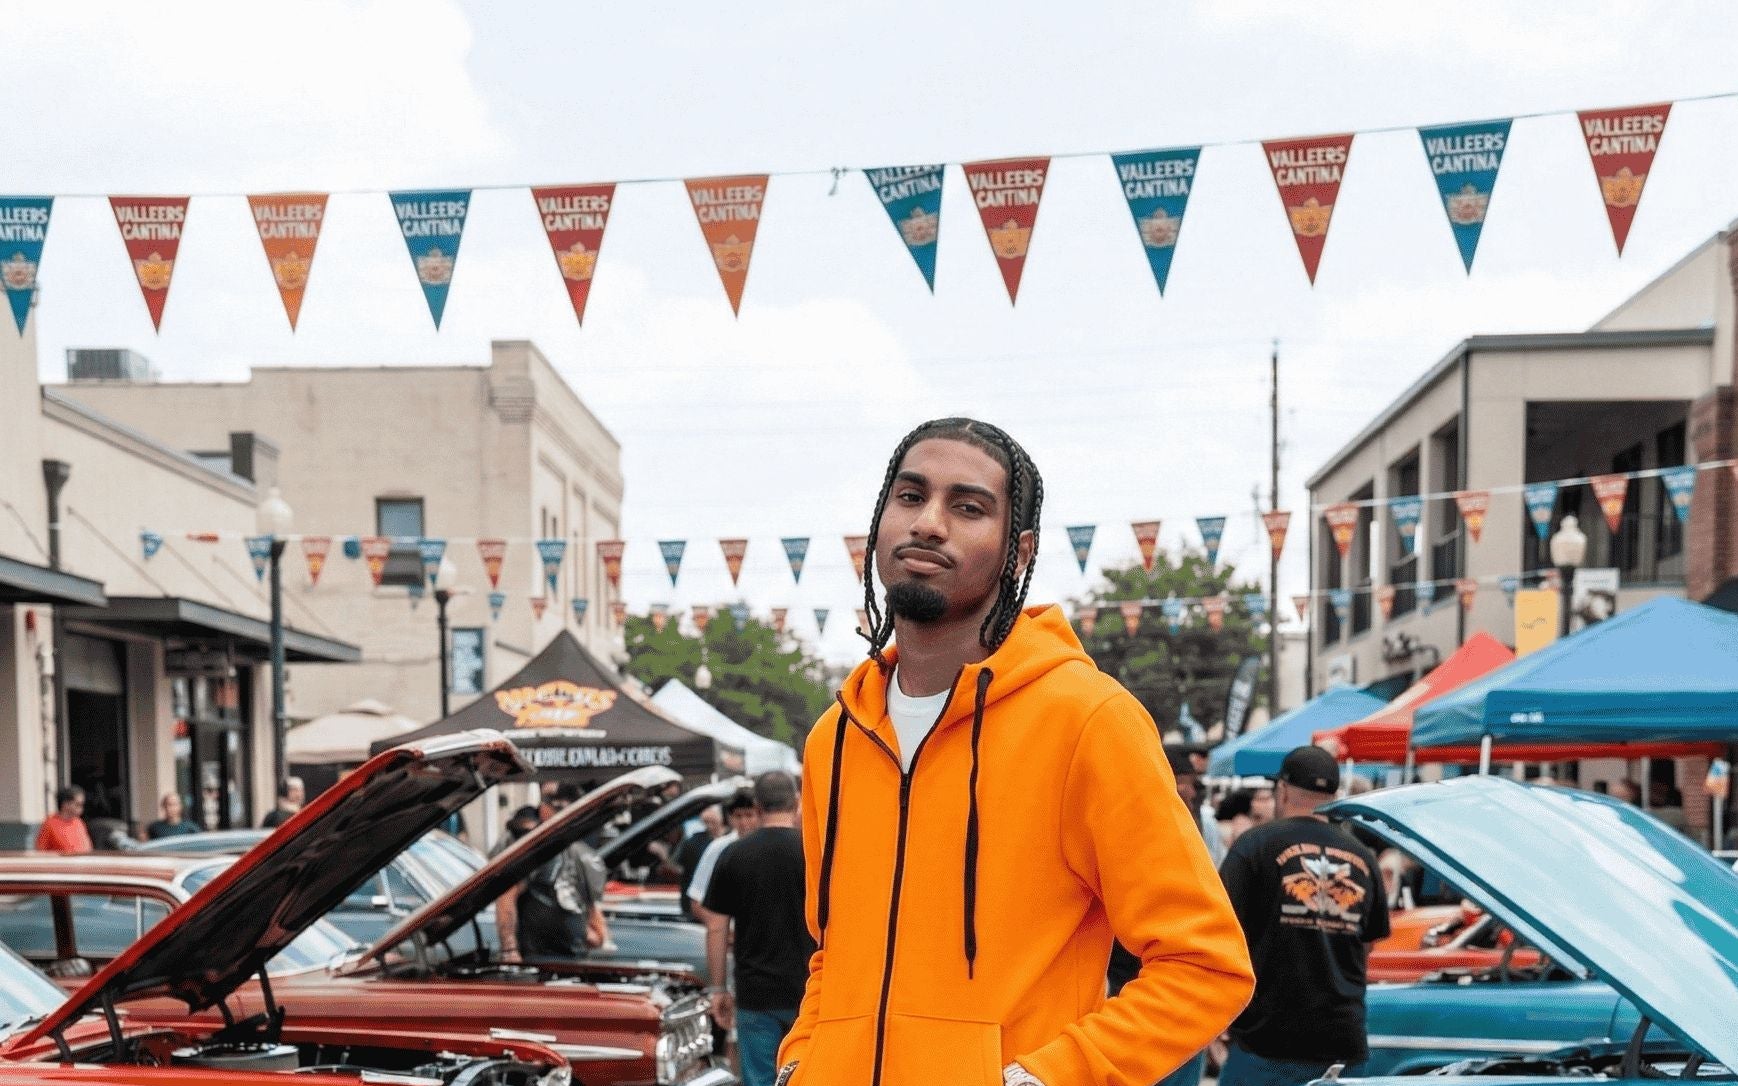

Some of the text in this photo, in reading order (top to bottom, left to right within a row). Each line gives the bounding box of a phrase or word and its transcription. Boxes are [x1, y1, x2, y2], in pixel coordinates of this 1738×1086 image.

[1584, 116, 1664, 137] VALLEERS
[1427, 133, 1504, 155] VALLEERS
[1590, 135, 1657, 155] CANTINA
[1270, 146, 1346, 167] VALLEERS
[1433, 152, 1499, 174] CANTINA
[969, 170, 1043, 190] VALLEERS
[1120, 159, 1194, 181] VALLEERS
[1276, 166, 1341, 186] CANTINA
[691, 185, 762, 204] VALLEERS
[879, 174, 940, 203] CANTINA
[975, 187, 1039, 208] CANTINA
[1126, 178, 1189, 199] CANTINA
[254, 204, 322, 221] VALLEERS
[394, 201, 466, 219] VALLEERS
[539, 195, 609, 213] VALLEERS
[699, 203, 759, 223] CANTINA
[0, 206, 48, 224] LLEERS
[115, 206, 184, 223] VALLEERS
[545, 213, 605, 231] CANTINA
[122, 223, 180, 240] CANTINA
[260, 221, 318, 238] CANTINA
[403, 218, 463, 237] CANTINA
